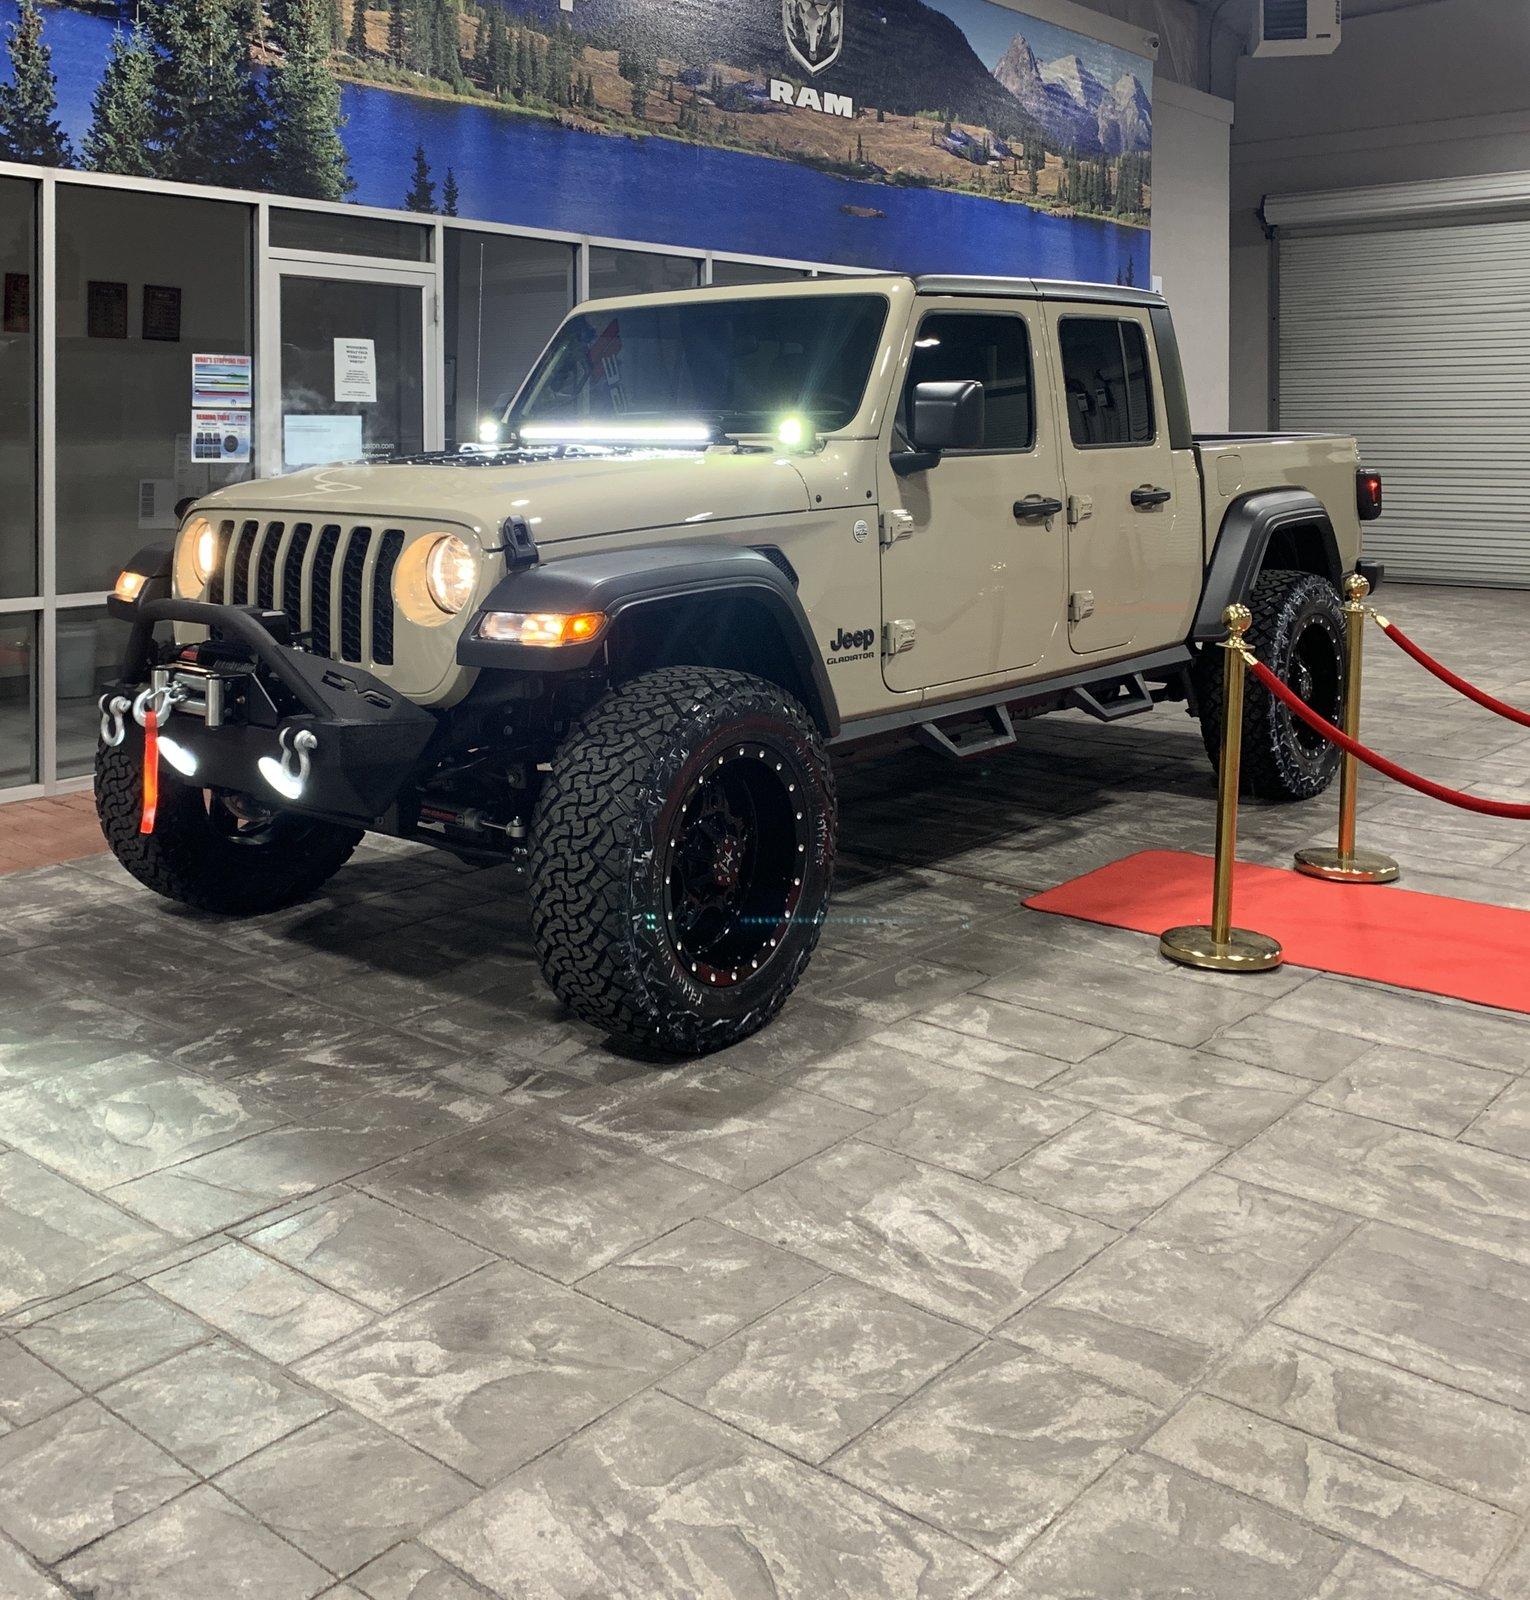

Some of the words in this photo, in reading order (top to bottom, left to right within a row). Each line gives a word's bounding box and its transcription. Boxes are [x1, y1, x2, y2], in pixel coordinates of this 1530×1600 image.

[770, 78, 853, 118] RAM
[830, 628, 875, 651] Jeep
[826, 651, 875, 665] GLADIATOR
